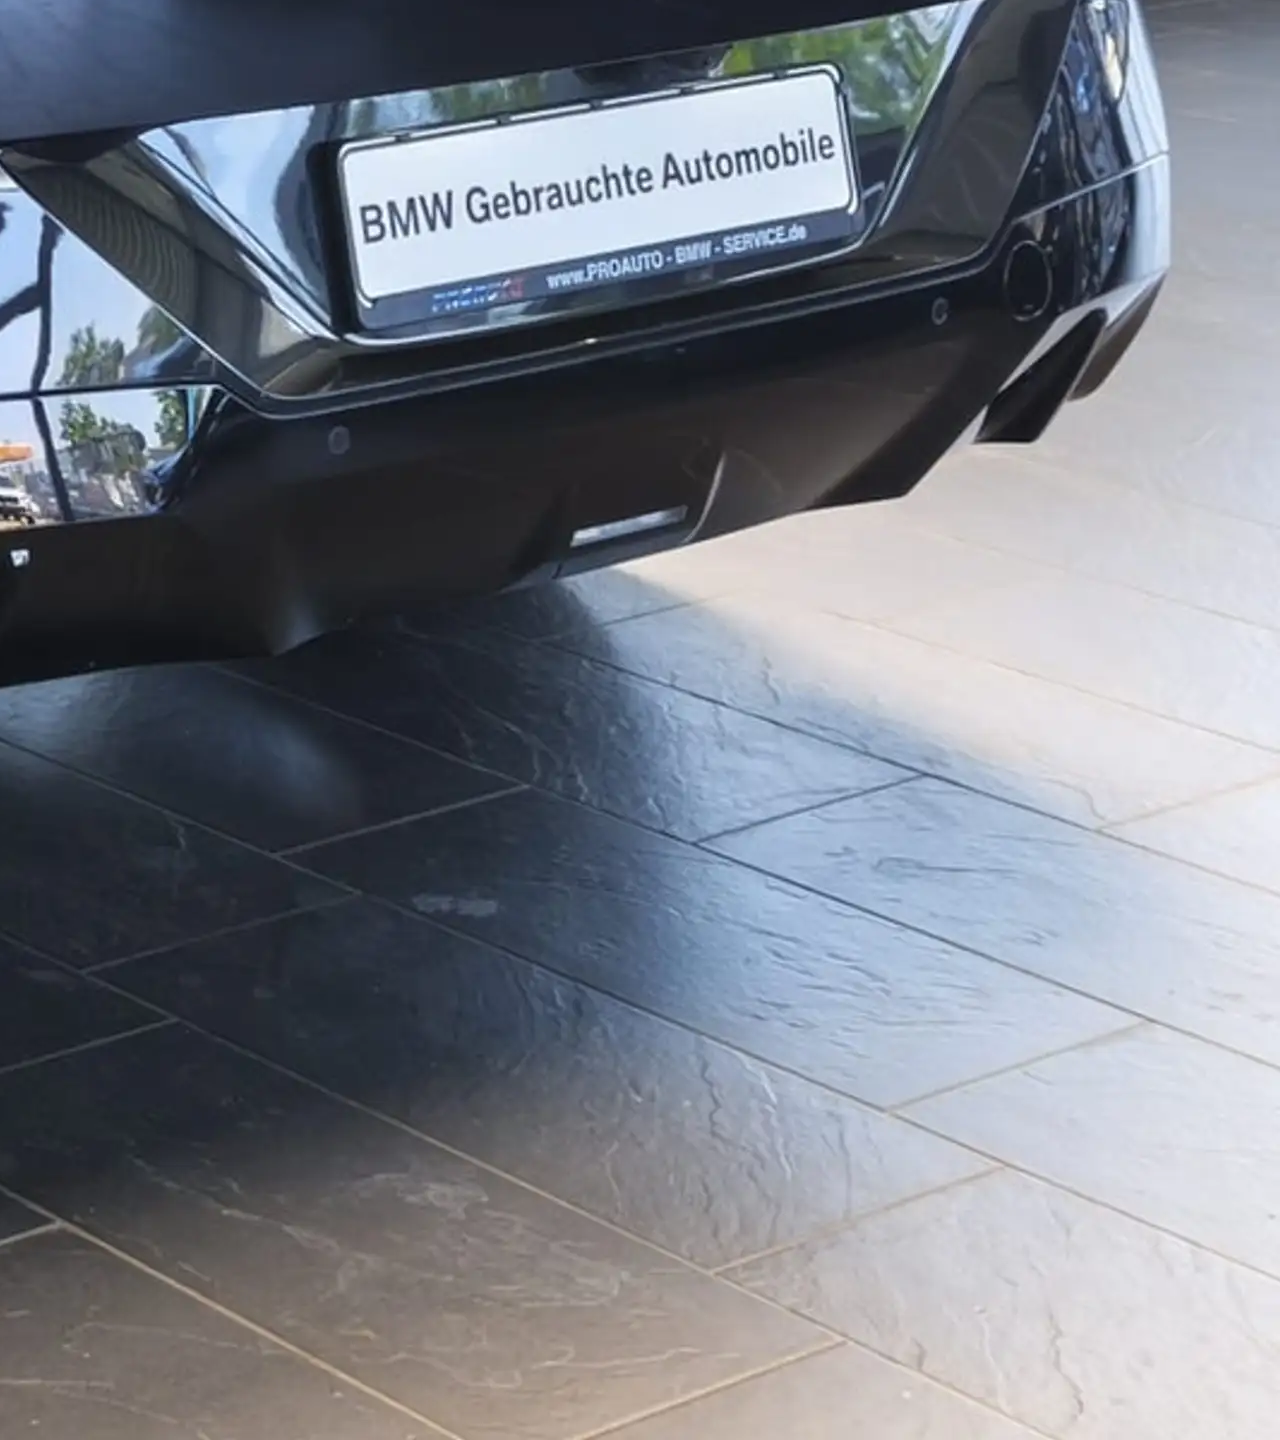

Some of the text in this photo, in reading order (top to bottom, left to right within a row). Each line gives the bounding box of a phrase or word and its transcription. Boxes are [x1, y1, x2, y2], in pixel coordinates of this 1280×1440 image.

[359, 127, 836, 245] BMW Gebrauchte Automobile
[546, 249, 663, 289] www.PROAUTO
[675, 239, 713, 265] BMW
[723, 223, 807, 255] SERVICE.de
